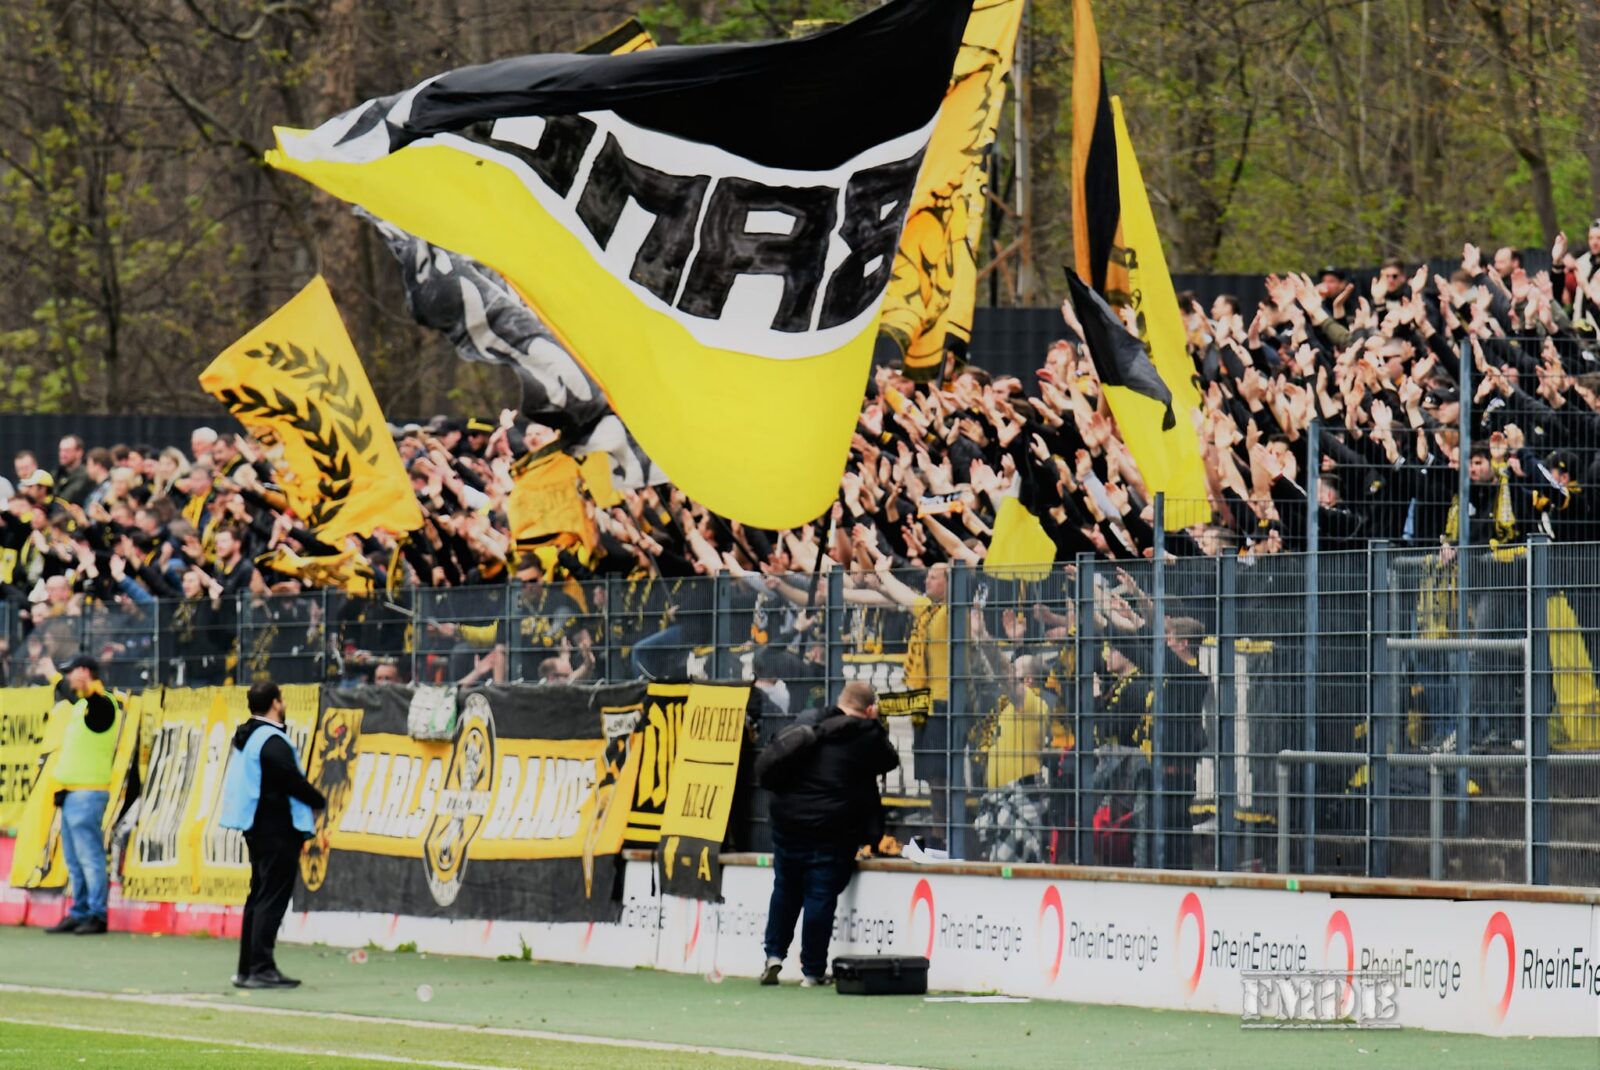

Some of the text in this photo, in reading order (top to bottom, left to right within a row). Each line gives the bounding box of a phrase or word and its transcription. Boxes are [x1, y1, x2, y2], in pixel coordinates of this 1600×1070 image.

[940, 913, 1022, 961] RheinEnergie
[1069, 921, 1159, 971] RheinEnergie
[1209, 929, 1307, 980] RheinEnergie
[1360, 947, 1461, 999] RheinEnerge
